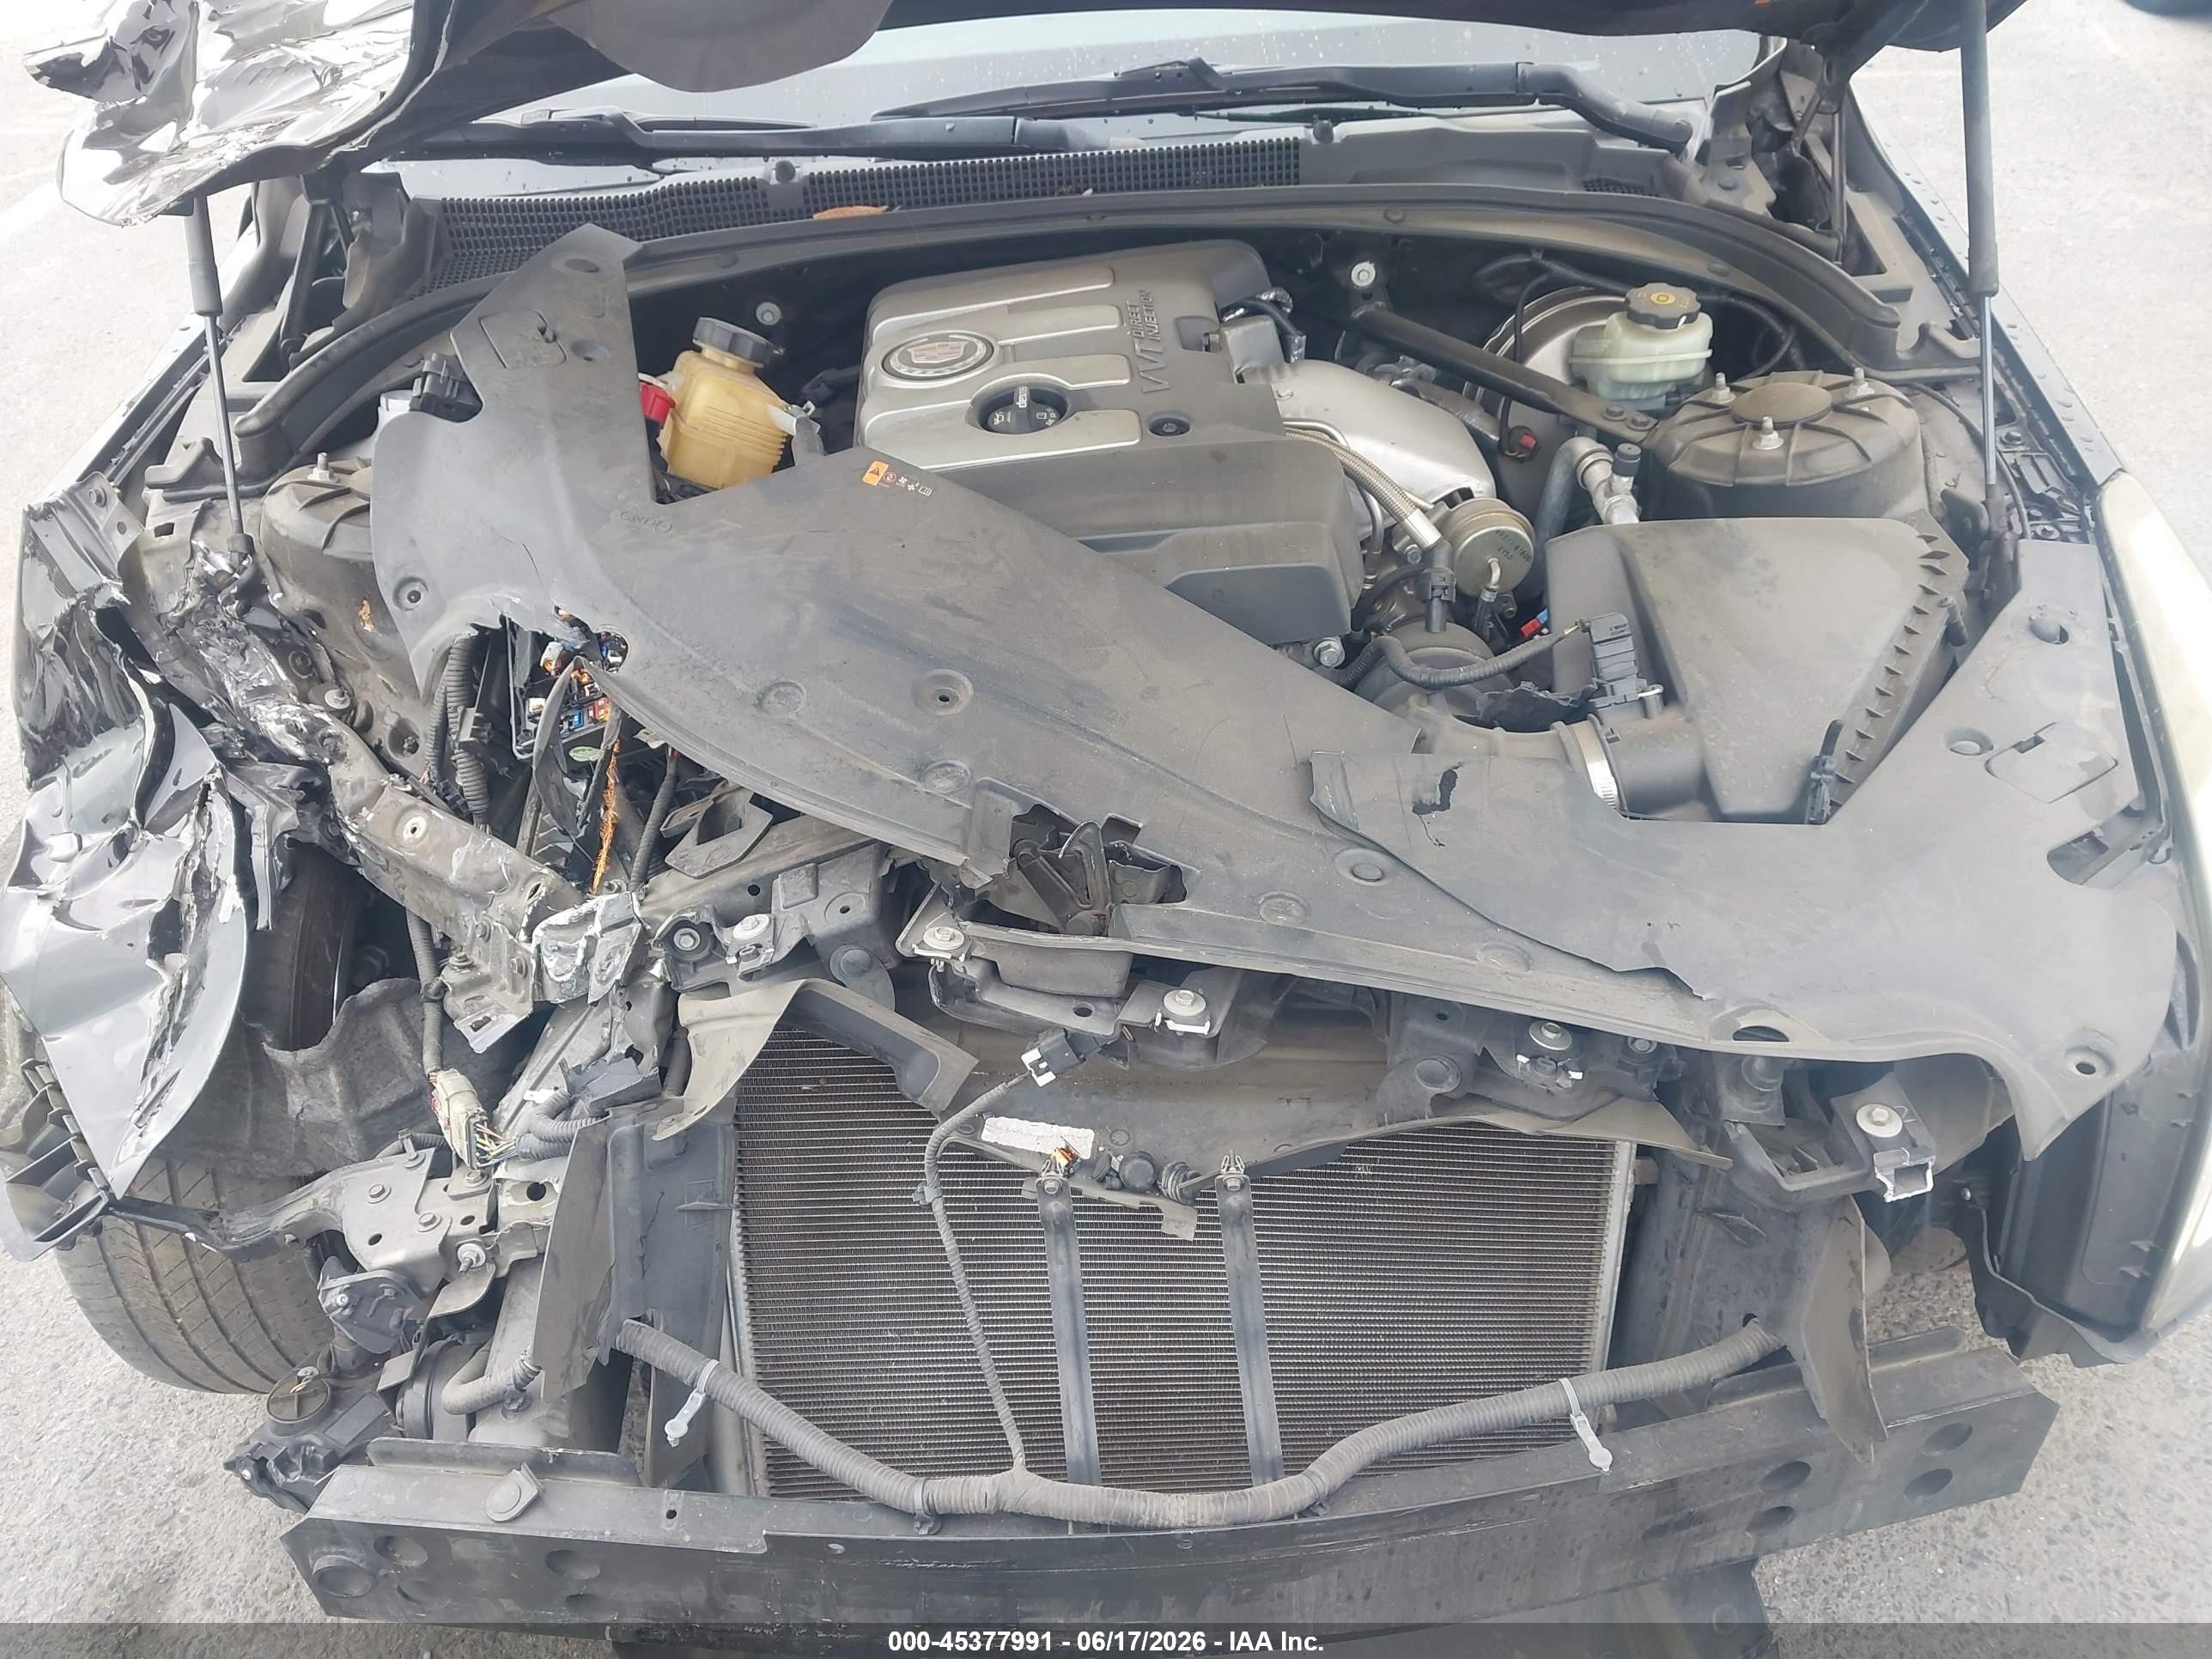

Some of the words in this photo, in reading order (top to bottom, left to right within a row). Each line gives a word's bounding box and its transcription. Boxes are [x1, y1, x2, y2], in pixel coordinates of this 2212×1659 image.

[1127, 301, 1146, 338] DIRECT
[1139, 289, 1161, 342] INJECTION
[1133, 338, 1171, 393] VVT
